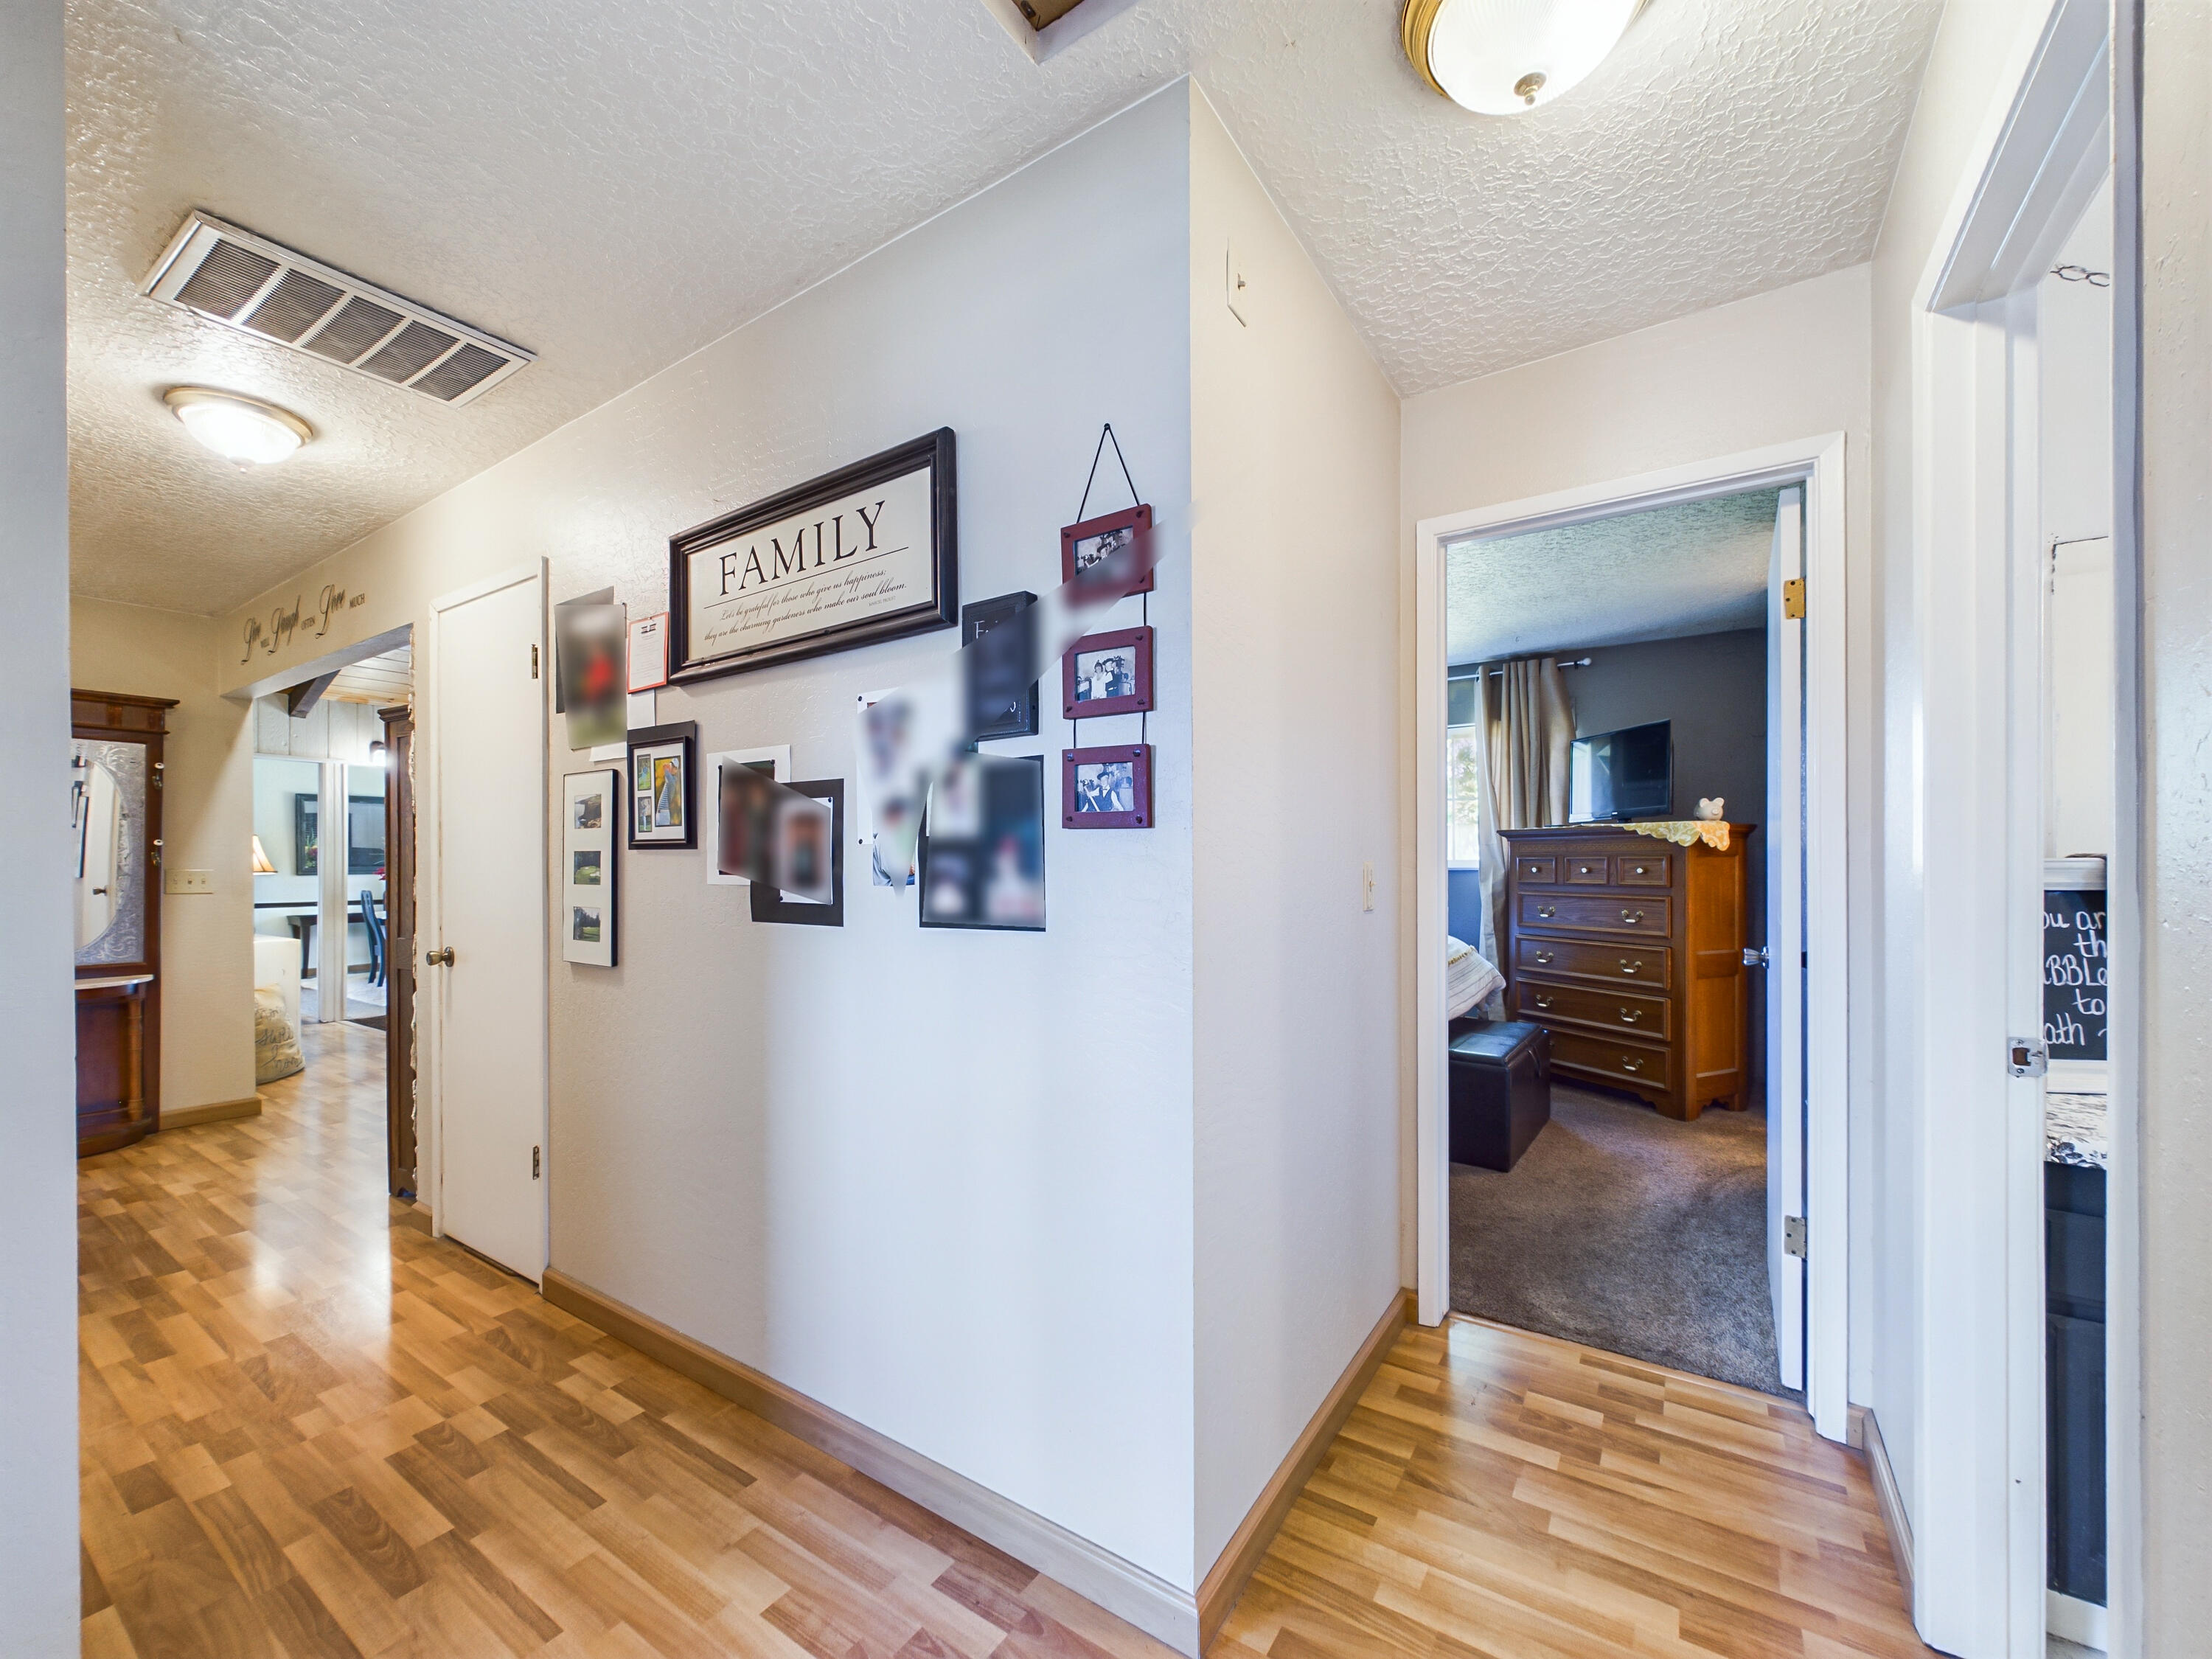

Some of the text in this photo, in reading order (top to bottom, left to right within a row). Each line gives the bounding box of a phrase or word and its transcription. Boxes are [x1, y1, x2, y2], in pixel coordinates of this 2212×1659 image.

[718, 500, 886, 596] FAMILY
[349, 593, 365, 608] MUCH
[704, 627, 717, 647] they
[728, 621, 739, 634] the
[740, 618, 771, 634] charming
[768, 608, 805, 633] gardeners
[807, 597, 822, 614] who
[824, 591, 845, 609] make
[846, 596, 859, 604] our
[860, 580, 883, 600] soul
[879, 577, 907, 595] bloom.
[736, 602, 743, 616] be
[743, 594, 773, 622] grateful
[767, 592, 779, 616] for
[782, 589, 799, 604] those
[800, 581, 815, 599] who
[812, 584, 832, 604] give
[2072, 989, 2106, 1015] to
